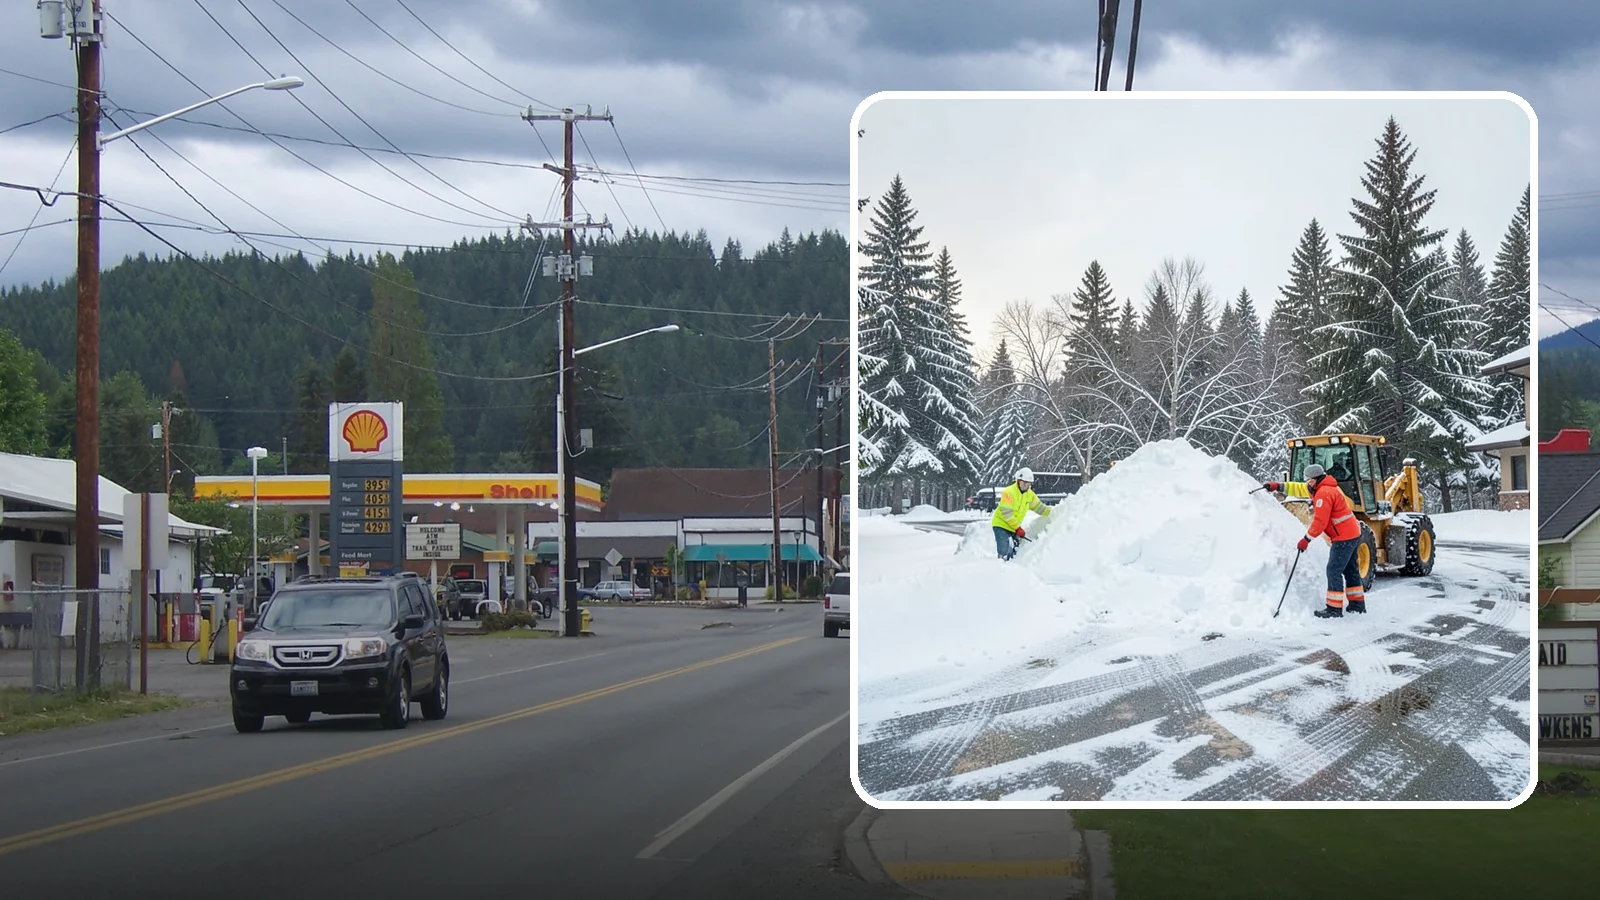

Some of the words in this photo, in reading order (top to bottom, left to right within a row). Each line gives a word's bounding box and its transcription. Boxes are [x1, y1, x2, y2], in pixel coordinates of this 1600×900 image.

[366, 480, 383, 490] 395
[490, 484, 547, 498] Shell
[366, 494, 383, 504] 405
[366, 508, 383, 518] 415
[366, 522, 383, 532] 429
[1538, 642, 1567, 665] AID
